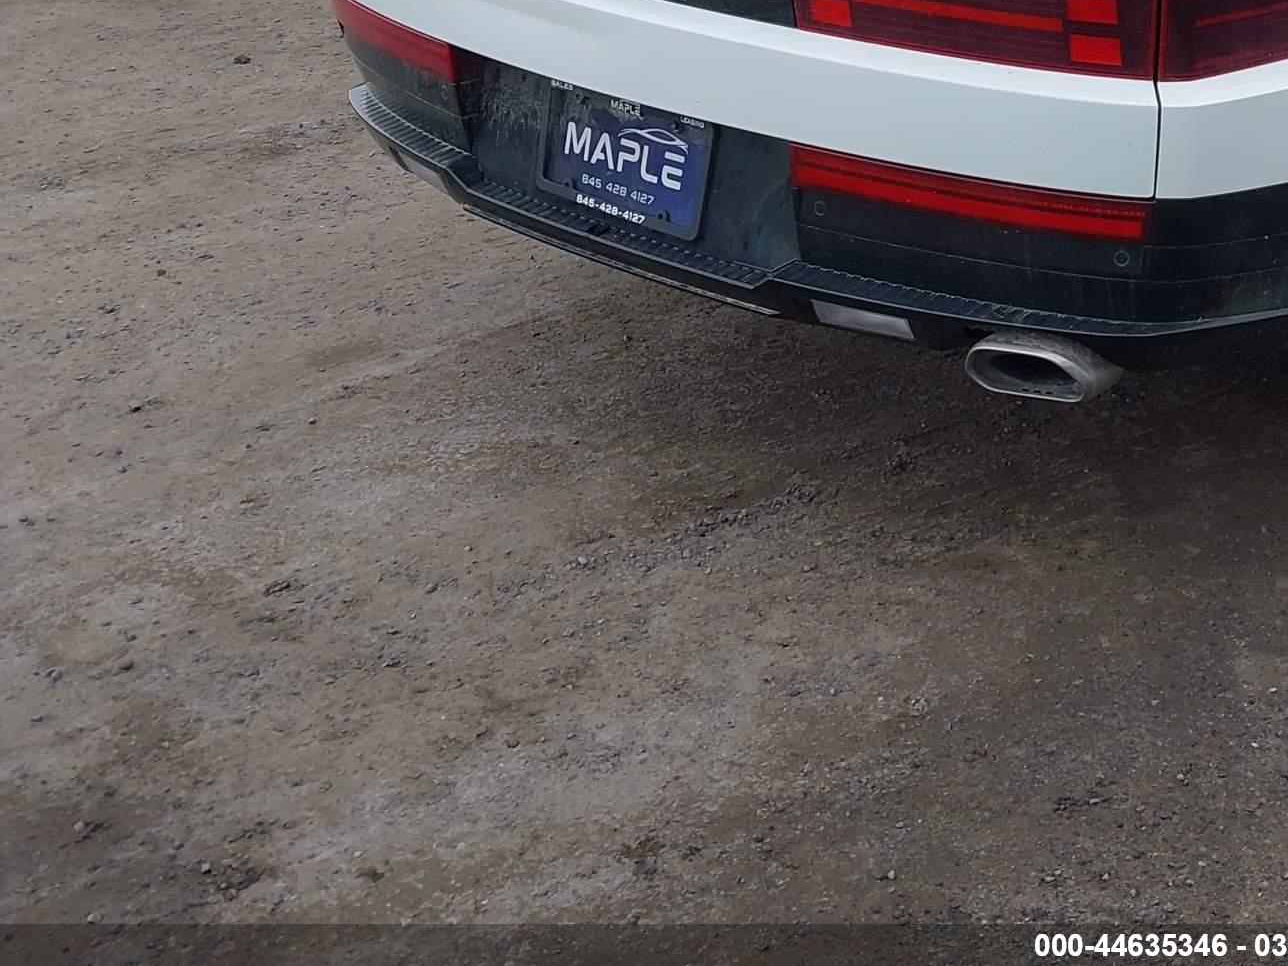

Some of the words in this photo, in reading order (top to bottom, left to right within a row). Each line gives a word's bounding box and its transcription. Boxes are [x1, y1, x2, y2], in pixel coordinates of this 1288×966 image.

[550, 79, 574, 91] SALES
[610, 99, 641, 116] MAPLE
[564, 121, 686, 191] MAPLE
[581, 173, 602, 189] 845
[605, 182, 628, 197] 428
[630, 190, 655, 205] 4127
[576, 193, 646, 224] 845-428-4127
